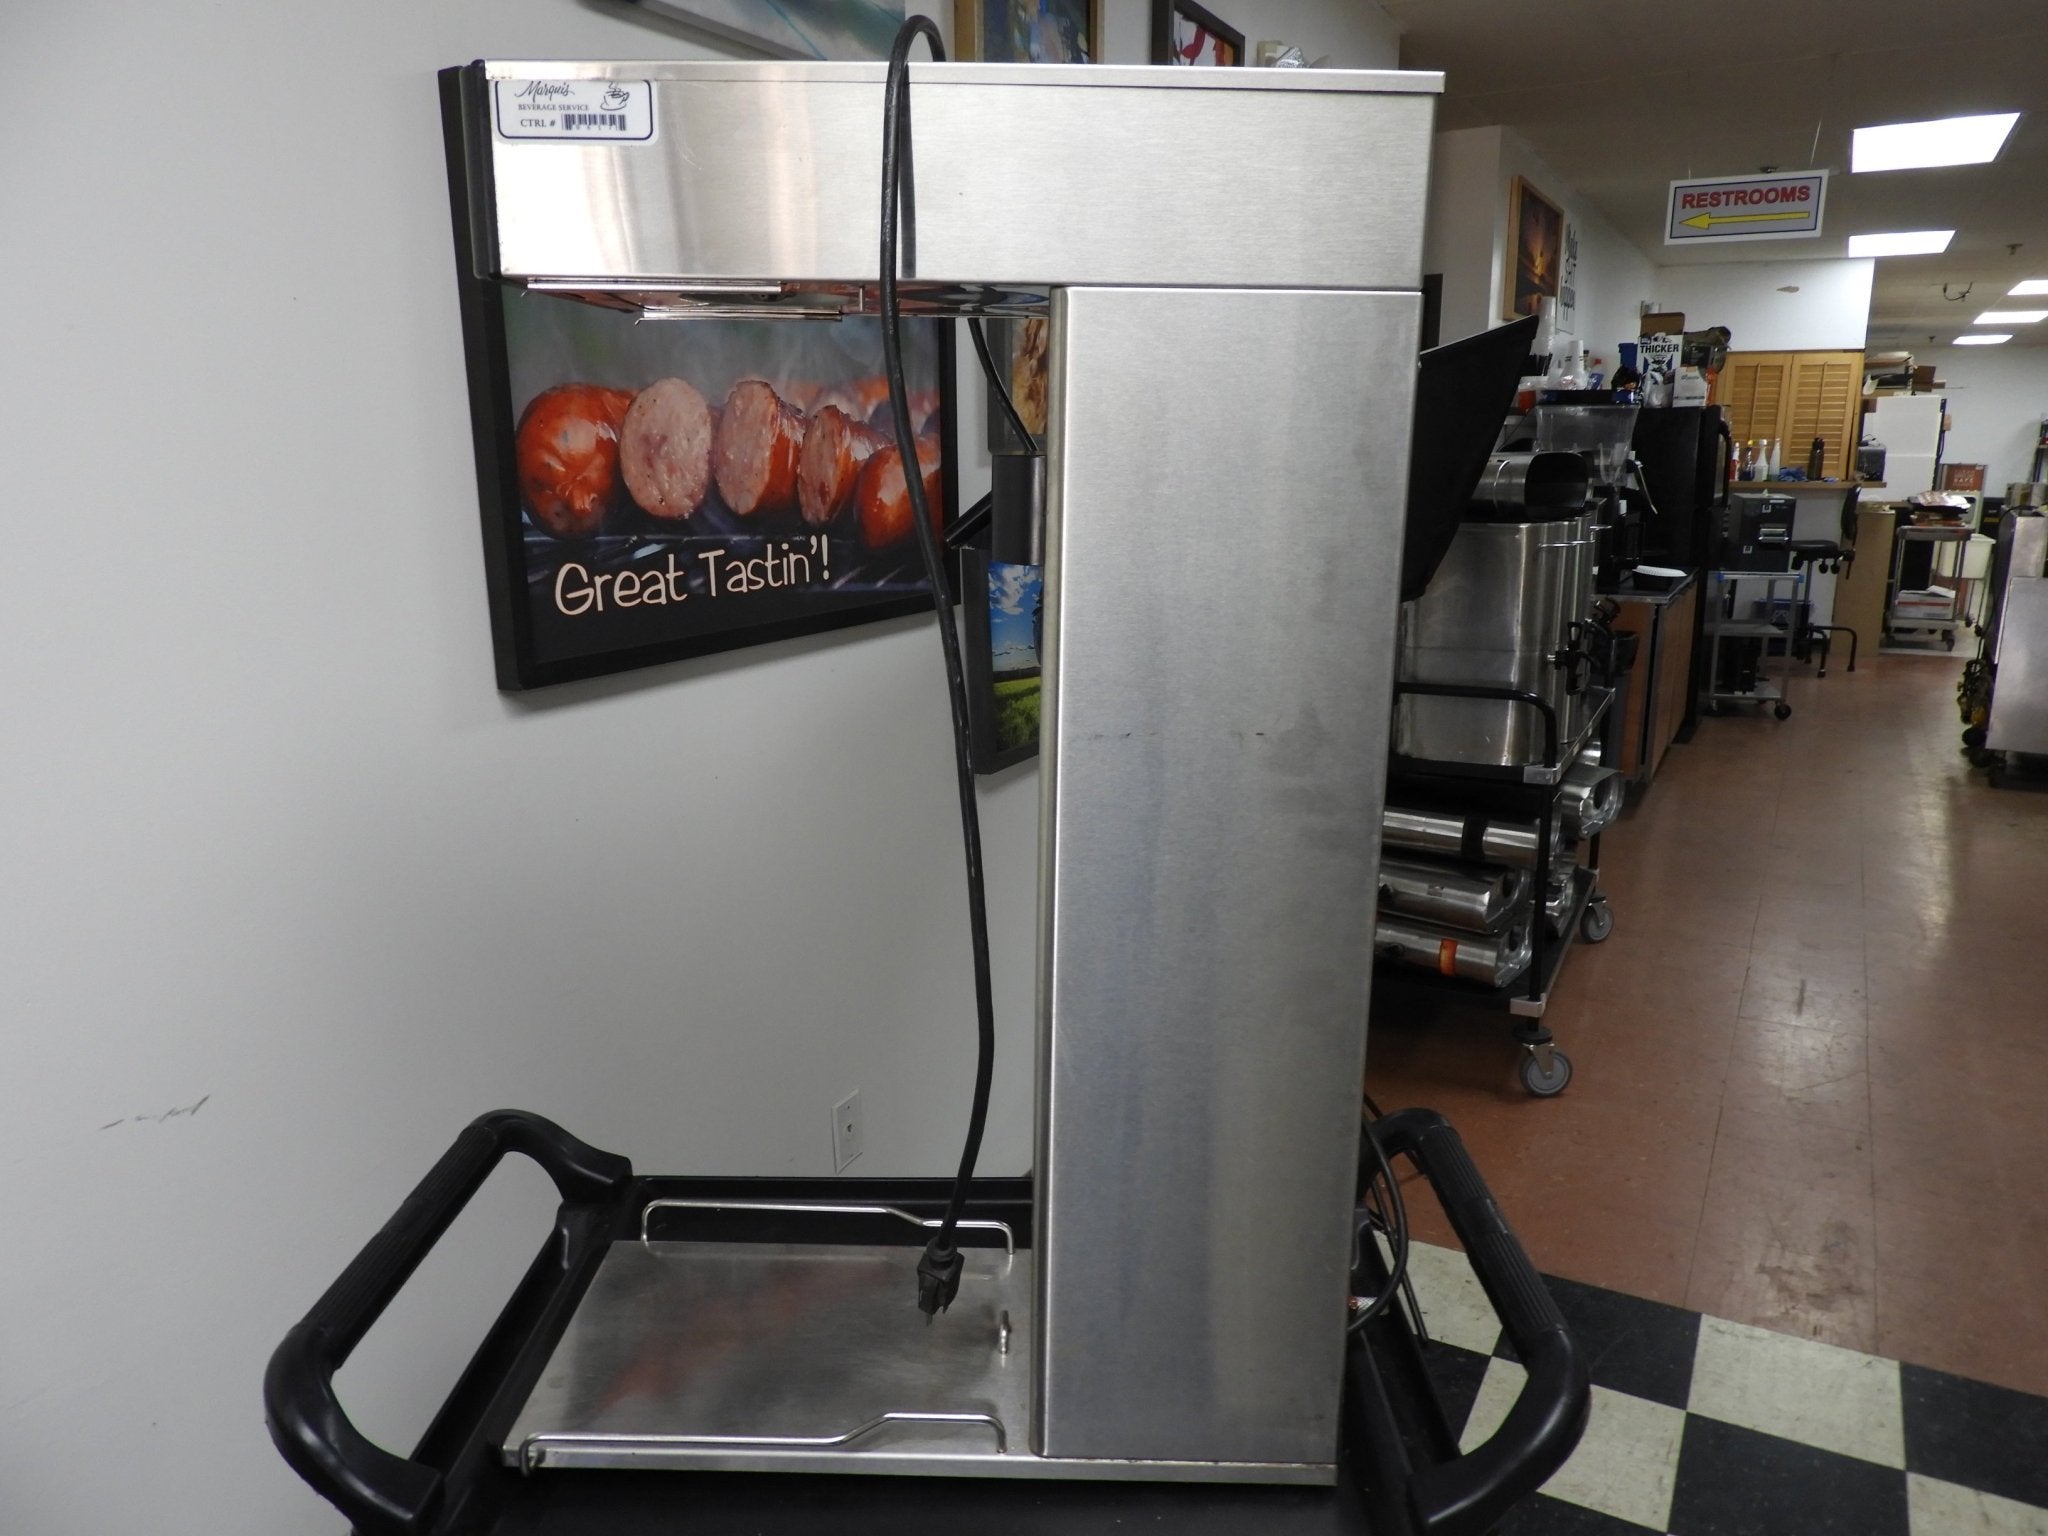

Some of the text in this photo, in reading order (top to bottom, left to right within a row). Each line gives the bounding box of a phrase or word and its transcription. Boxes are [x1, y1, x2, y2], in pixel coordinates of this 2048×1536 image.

[515, 80, 575, 102] Marquis
[520, 118, 556, 127] CTRL #
[1681, 185, 1811, 210] RESTROOMS
[1639, 344, 1680, 354] THICKER
[554, 533, 830, 616] Great Tastin'!
